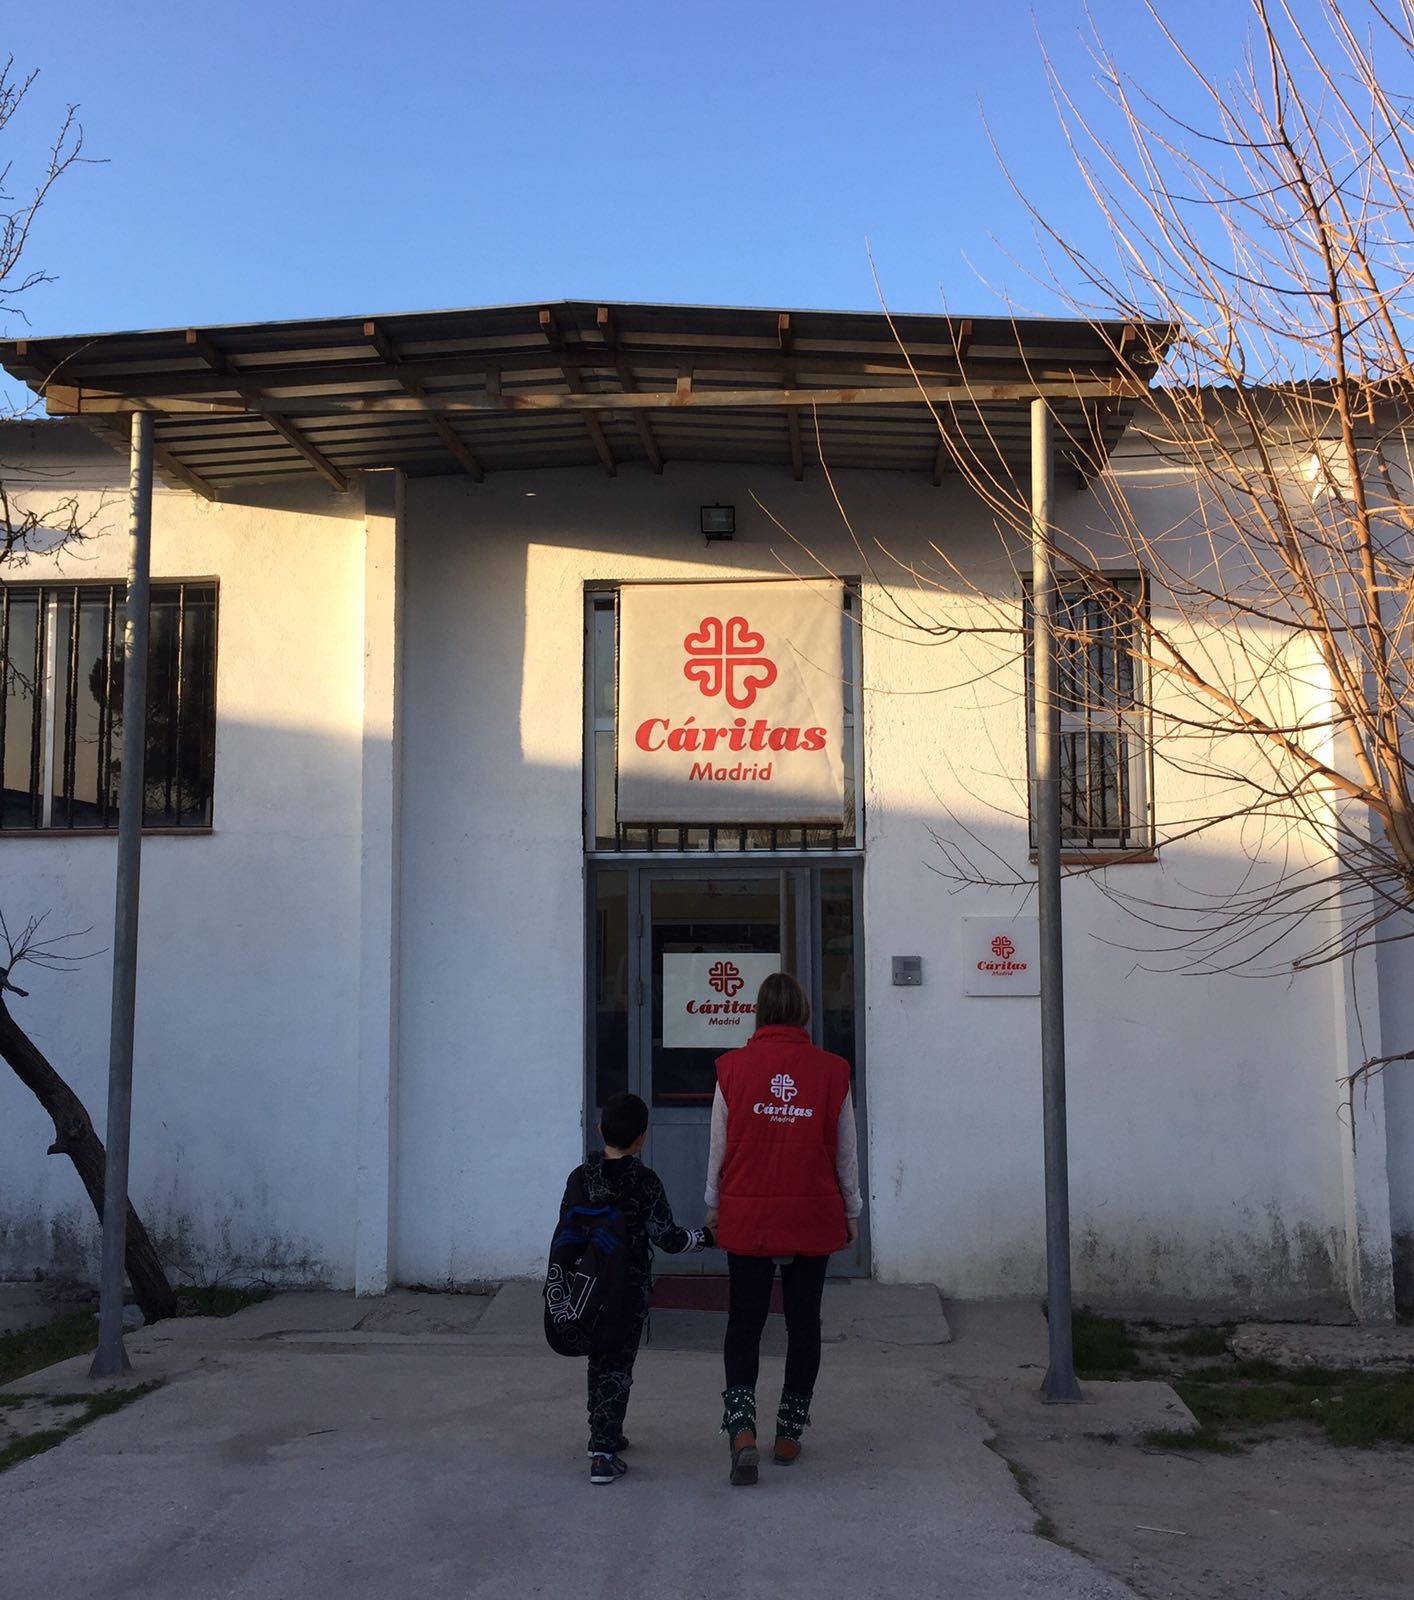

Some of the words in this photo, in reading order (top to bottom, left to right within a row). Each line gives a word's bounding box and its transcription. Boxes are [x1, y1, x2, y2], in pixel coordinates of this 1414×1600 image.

[635, 716, 827, 752] Cáritas
[688, 762, 773, 781] Madrid
[977, 960, 1027, 971] Cáritas
[708, 1017, 741, 1026] Madrid
[753, 1102, 813, 1117] Cáritas
[770, 1115, 796, 1123] Madrid
